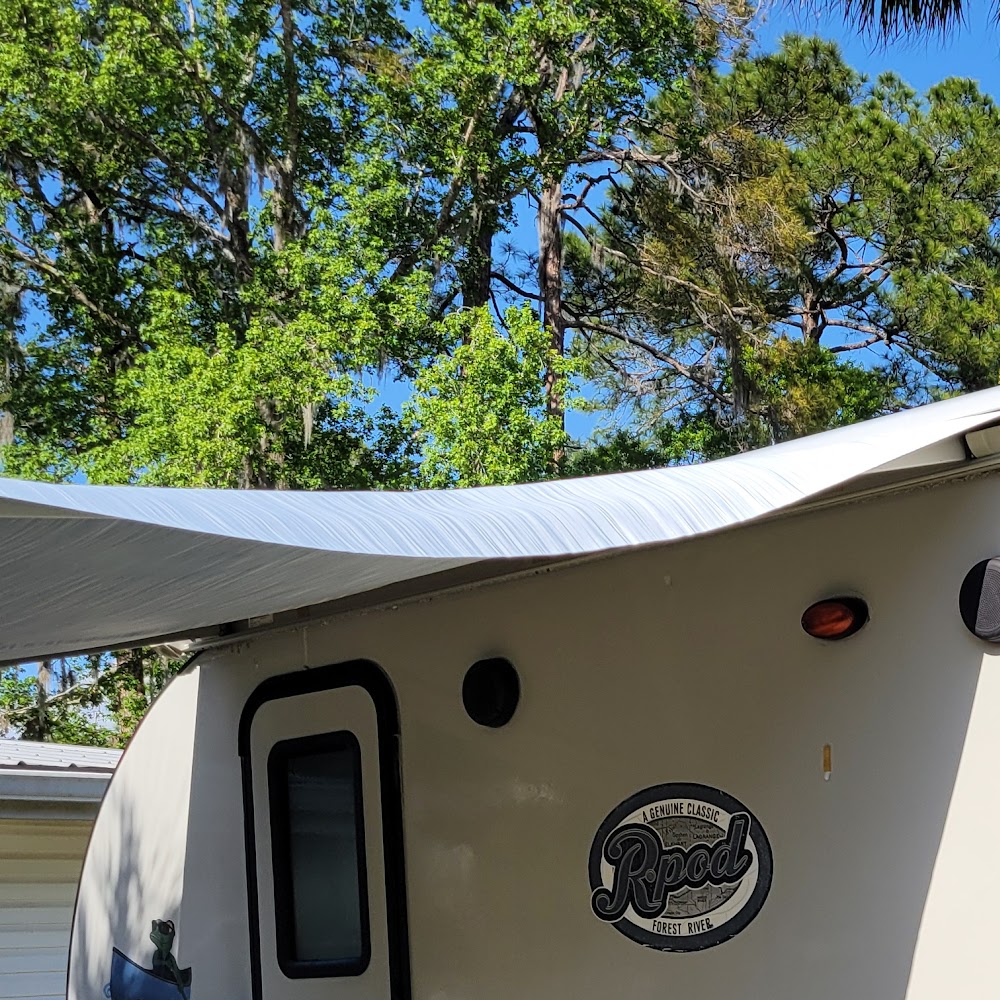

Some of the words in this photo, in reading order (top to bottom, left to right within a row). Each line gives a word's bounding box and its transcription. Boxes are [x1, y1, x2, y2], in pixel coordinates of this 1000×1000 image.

[643, 811, 648, 823] A
[649, 802, 684, 819] GENUINE
[687, 802, 720, 823] CLASSIC
[652, 919, 682, 935] FOREST
[687, 917, 713, 934] RIVER
